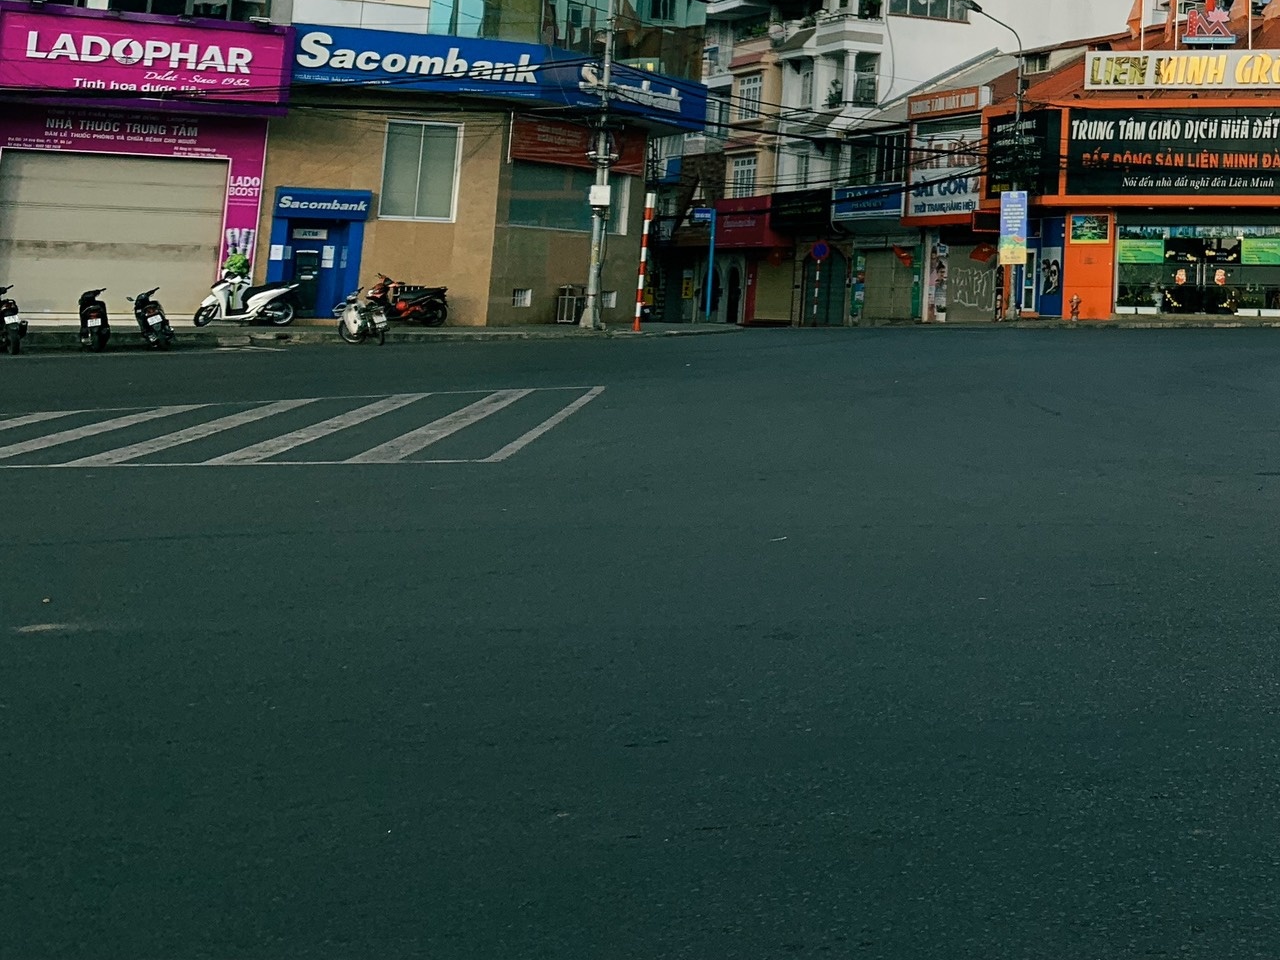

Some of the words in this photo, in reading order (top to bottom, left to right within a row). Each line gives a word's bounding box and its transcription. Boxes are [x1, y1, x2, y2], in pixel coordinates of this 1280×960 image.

[26, 30, 254, 74] LADOPHAR
[296, 31, 541, 84] Sacombank
[1154, 54, 1227, 84] MINH
[110, 80, 137, 91] hoa
[144, 71, 178, 82] Dalat
[189, 74, 217, 85] Since
[221, 77, 250, 87] 1982
[46, 118, 73, 129] NHÀ
[80, 119, 120, 132] THUỐC
[125, 123, 167, 135] TRUNG
[1071, 119, 1115, 140] TRUNG
[1119, 117, 1146, 140] TÂM
[1148, 119, 1181, 140] GIAO
[1184, 118, 1218, 143] DỊCH
[1220, 116, 1250, 139] NHÀ
[1252, 113, 1280, 139] ĐẤT
[1155, 147, 1184, 167] SẢN
[1187, 149, 1219, 168] LIÊN
[1222, 152, 1258, 169] MINH
[229, 175, 261, 187] LADO
[1122, 177, 1138, 188] Nói
[1138, 176, 1154, 188] đến
[1156, 176, 1172, 188] nhà
[1174, 175, 1188, 188] đất
[1190, 177, 1209, 190] nghĩ
[1211, 175, 1226, 188] đến
[1229, 177, 1248, 188] Liên
[1250, 177, 1274, 188] Minh
[228, 187, 260, 197] BOOST
[279, 195, 368, 212] Sacombank
